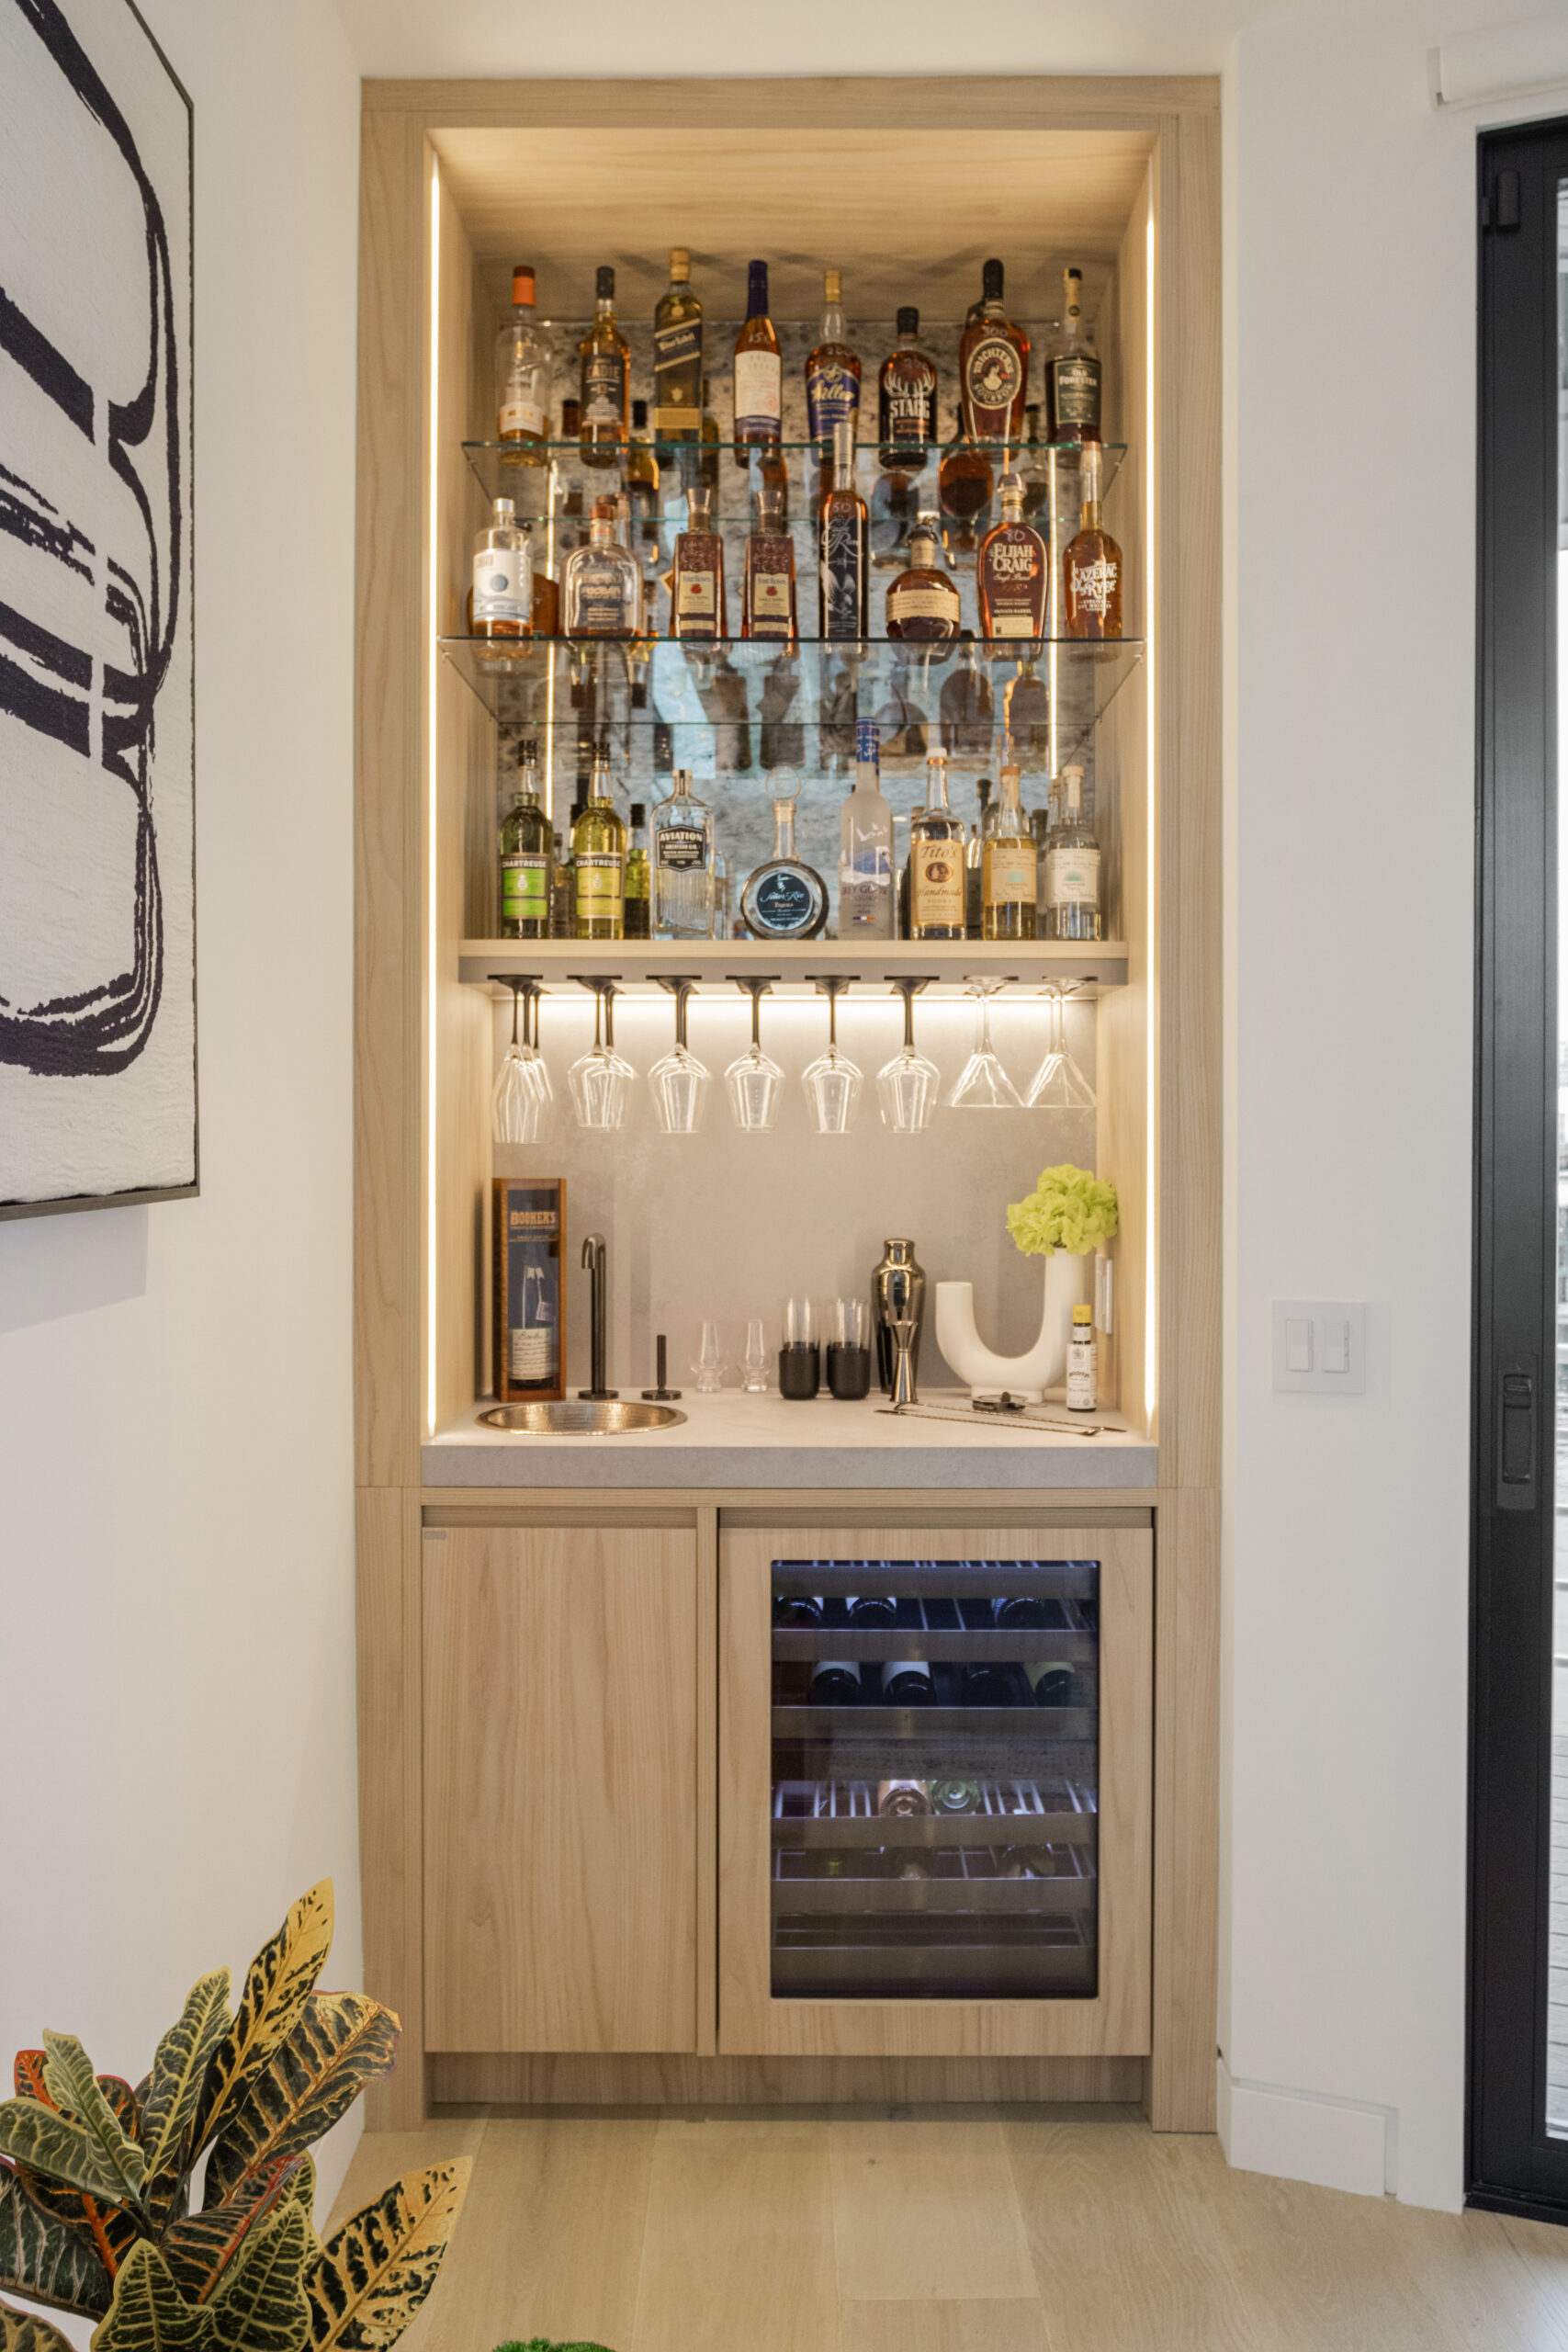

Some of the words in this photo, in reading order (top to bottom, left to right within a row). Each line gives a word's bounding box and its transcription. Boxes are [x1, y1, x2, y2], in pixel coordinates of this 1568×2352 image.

[889, 398, 931, 420] STAGG
[831, 503, 852, 514] 50
[1004, 528, 1026, 543] 80
[992, 543, 1033, 559] ELIJAH
[992, 557, 1032, 573] CRAIG
[660, 831, 703, 842] AVIATION
[920, 844, 958, 859] Tito's
[502, 859, 547, 868] CHARTREUSE
[576, 859, 622, 867] CHARTREUSE
